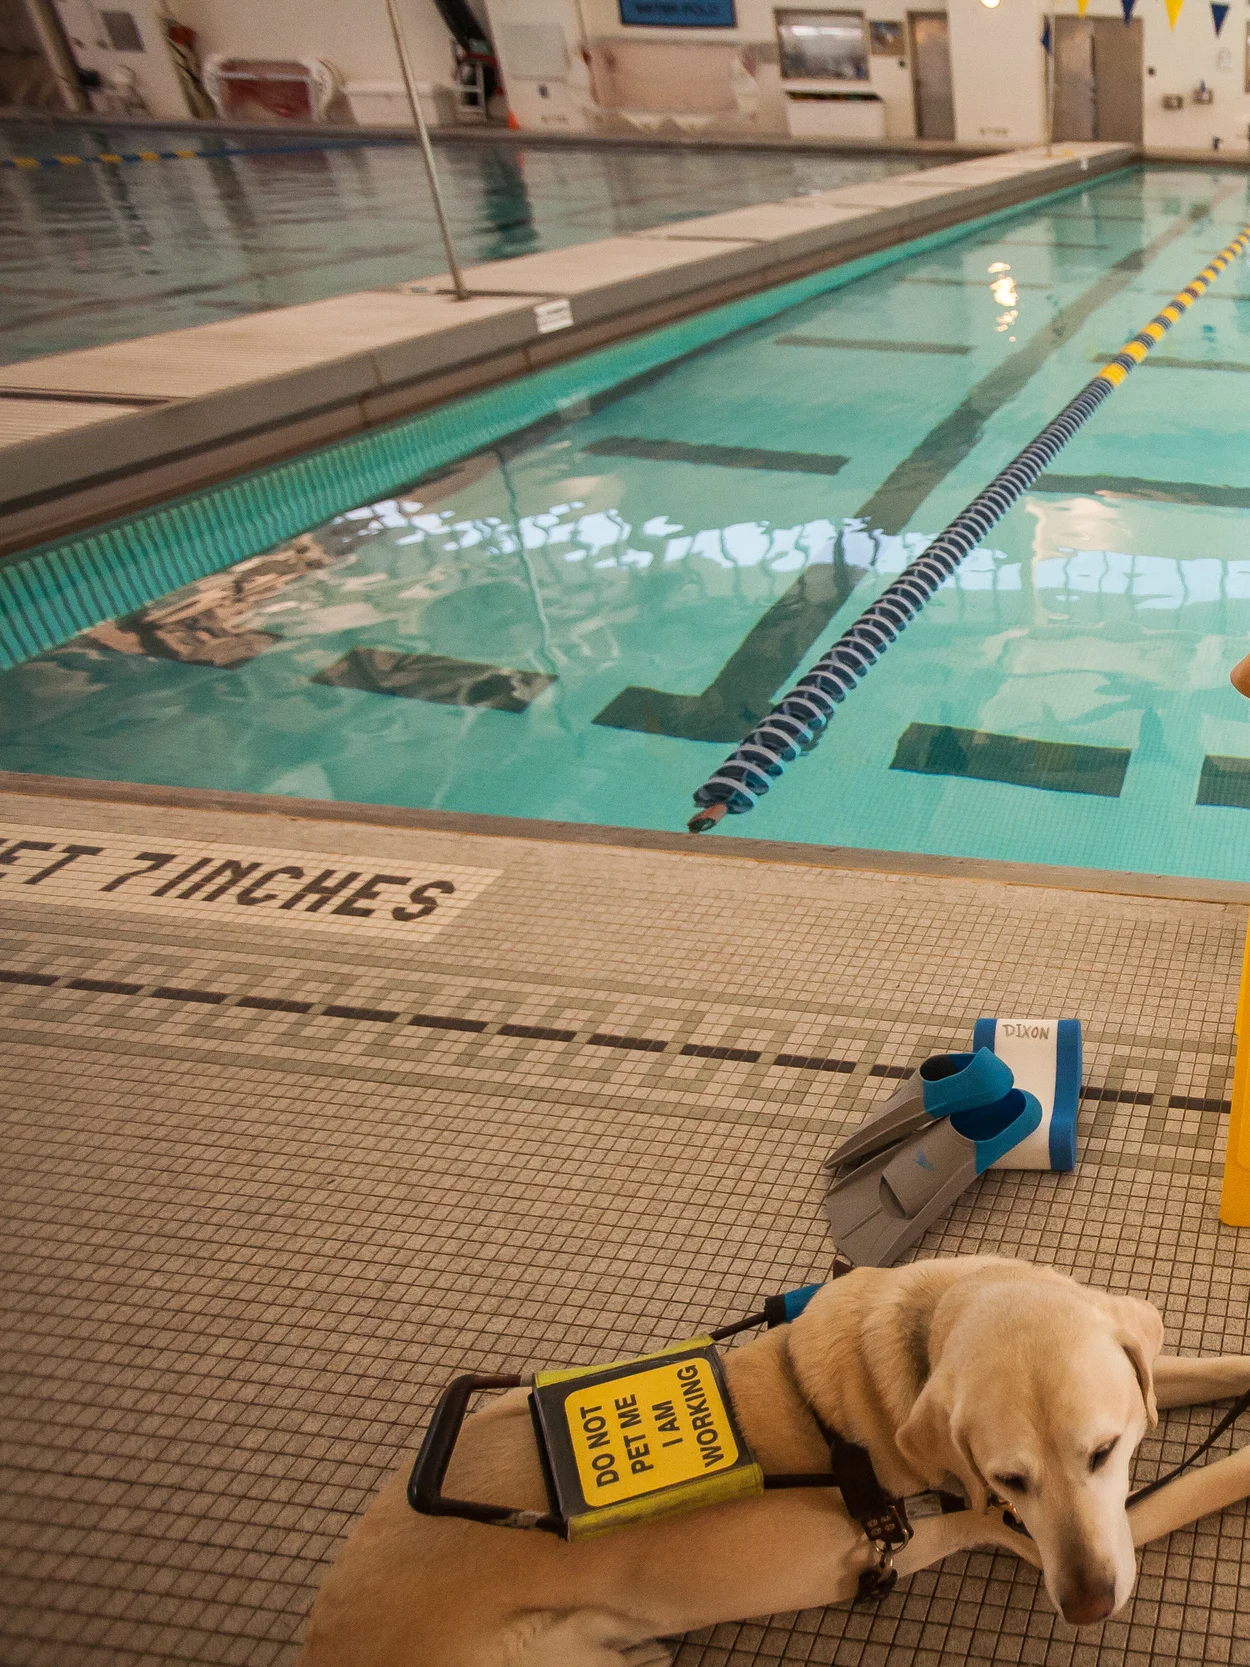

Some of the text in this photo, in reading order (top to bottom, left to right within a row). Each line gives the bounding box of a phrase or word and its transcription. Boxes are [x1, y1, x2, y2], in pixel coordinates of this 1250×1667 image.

[0, 837, 455, 923] ET 7 INCHES
[1002, 1023, 1050, 1041] DIXON
[580, 1404, 620, 1488] DO NOT
[613, 1393, 654, 1475] PET ME
[651, 1399, 684, 1448] I AM
[676, 1364, 725, 1468] WORKING
